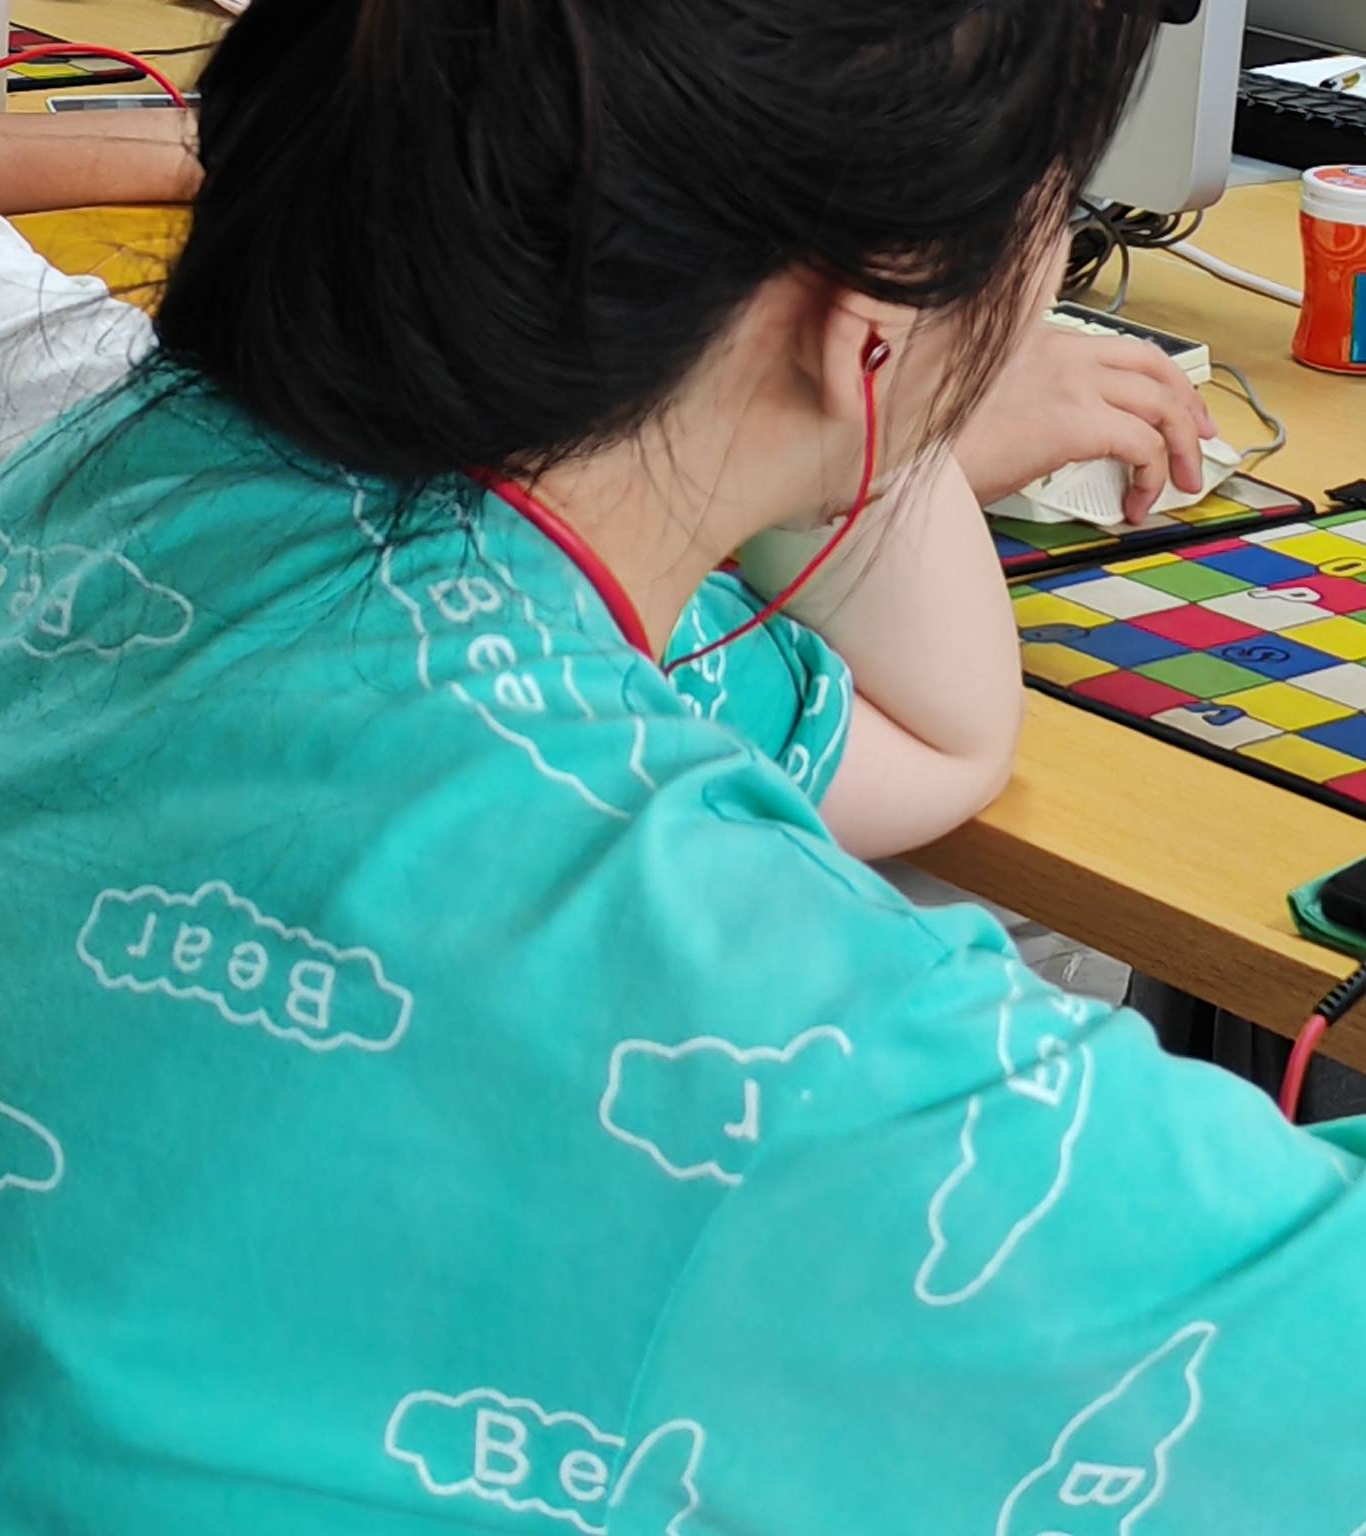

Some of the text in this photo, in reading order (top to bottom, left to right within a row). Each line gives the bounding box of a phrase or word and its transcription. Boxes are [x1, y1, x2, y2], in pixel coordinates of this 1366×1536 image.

[427, 575, 546, 713] Bea
[126, 909, 339, 1030] Bear
[474, 1408, 608, 1502] Be
